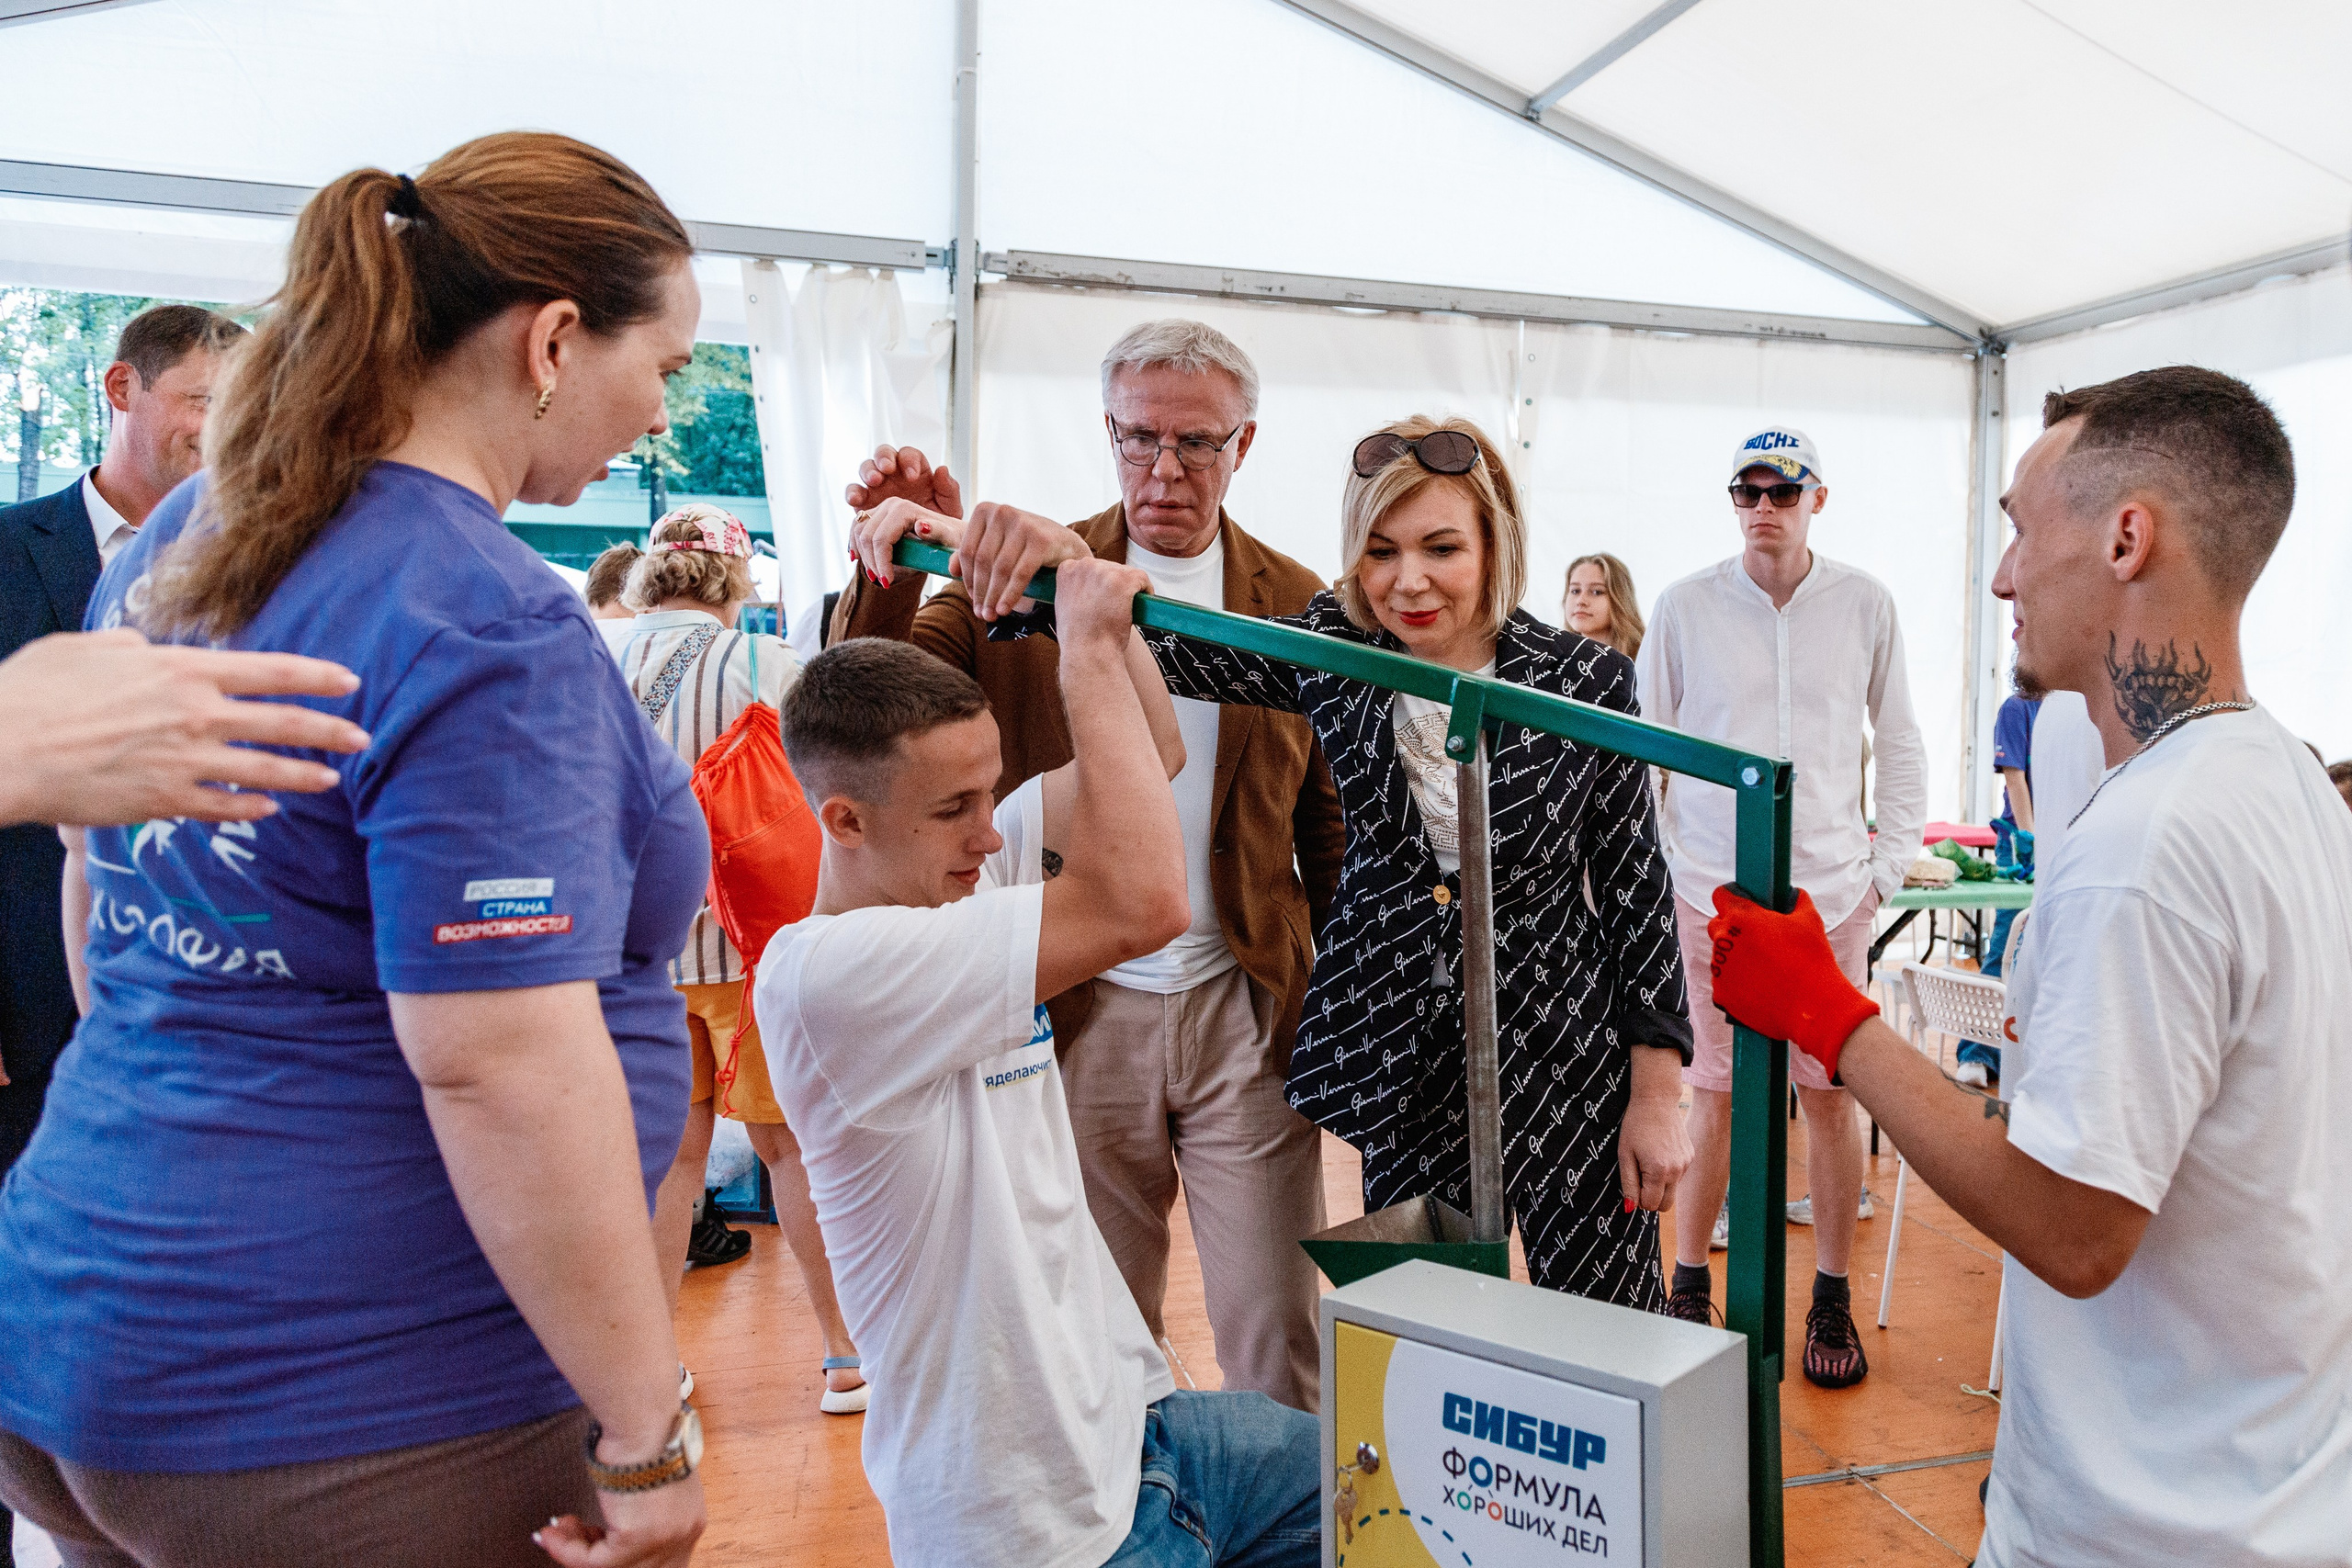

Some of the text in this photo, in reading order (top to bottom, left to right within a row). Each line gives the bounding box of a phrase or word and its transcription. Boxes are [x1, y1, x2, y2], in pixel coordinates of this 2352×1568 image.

[1744, 432, 1799, 450] SOCHI
[482, 900, 548, 918] СТРАНА
[1442, 1392, 1607, 1471] СИБУР
[1442, 1446, 1608, 1527] ФОРМУЛА
[1442, 1483, 1609, 1559] ХОРОШИХ ДЕЛ
